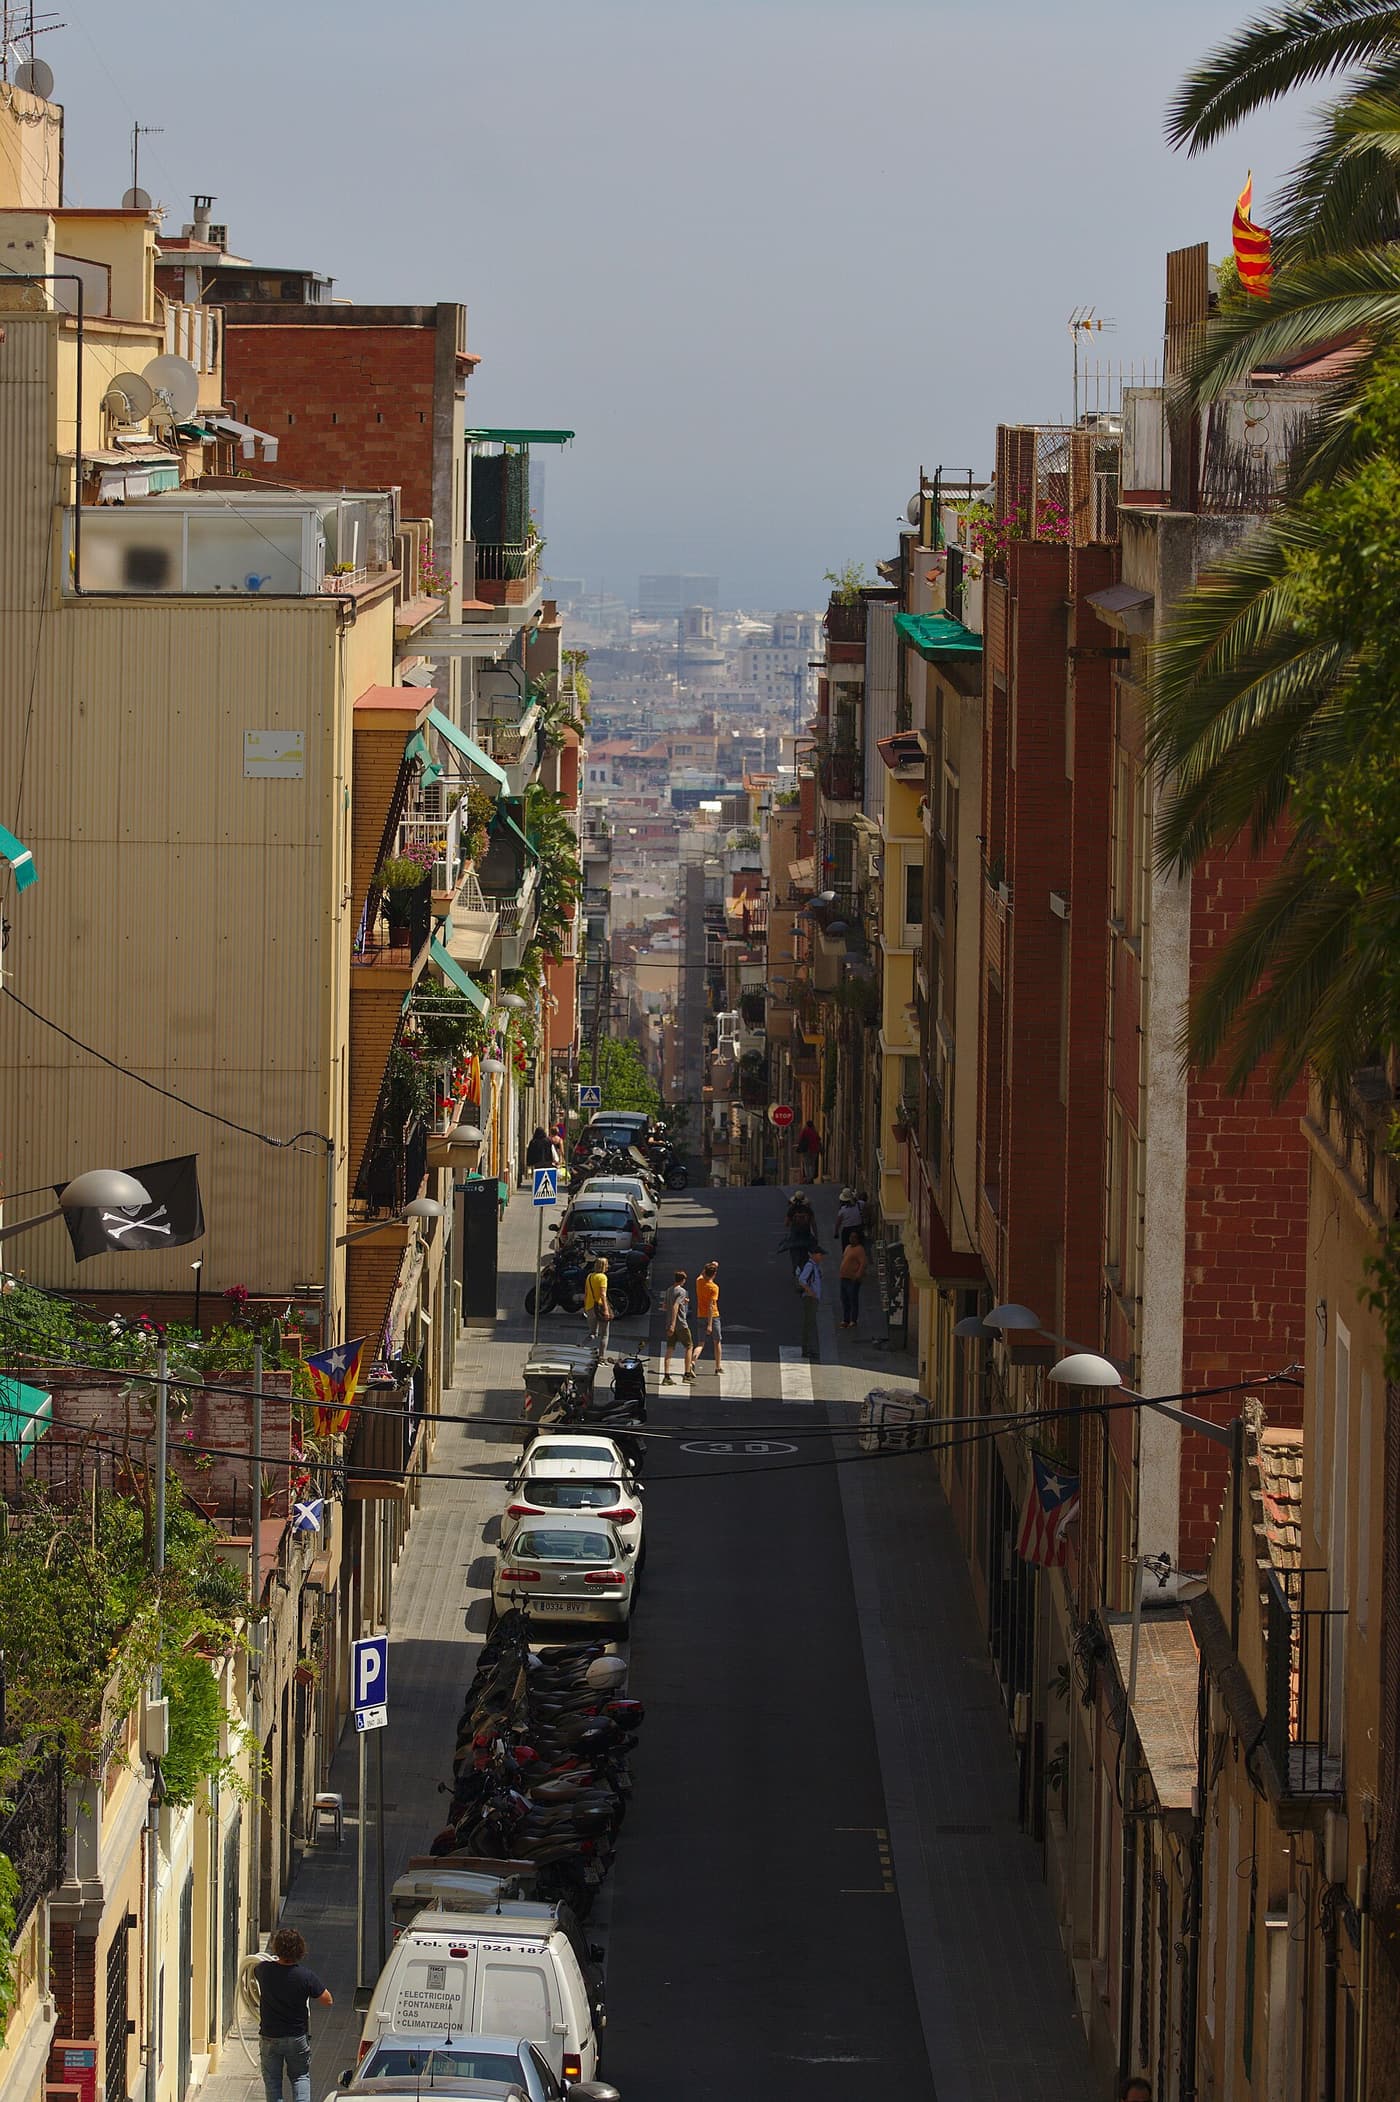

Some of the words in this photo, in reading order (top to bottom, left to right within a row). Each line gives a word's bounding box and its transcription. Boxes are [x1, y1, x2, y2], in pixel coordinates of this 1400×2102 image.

[360, 1648, 381, 1701] P
[404, 1991, 461, 2001] ELECTRICIDAD
[402, 2010, 419, 2018] GAS
